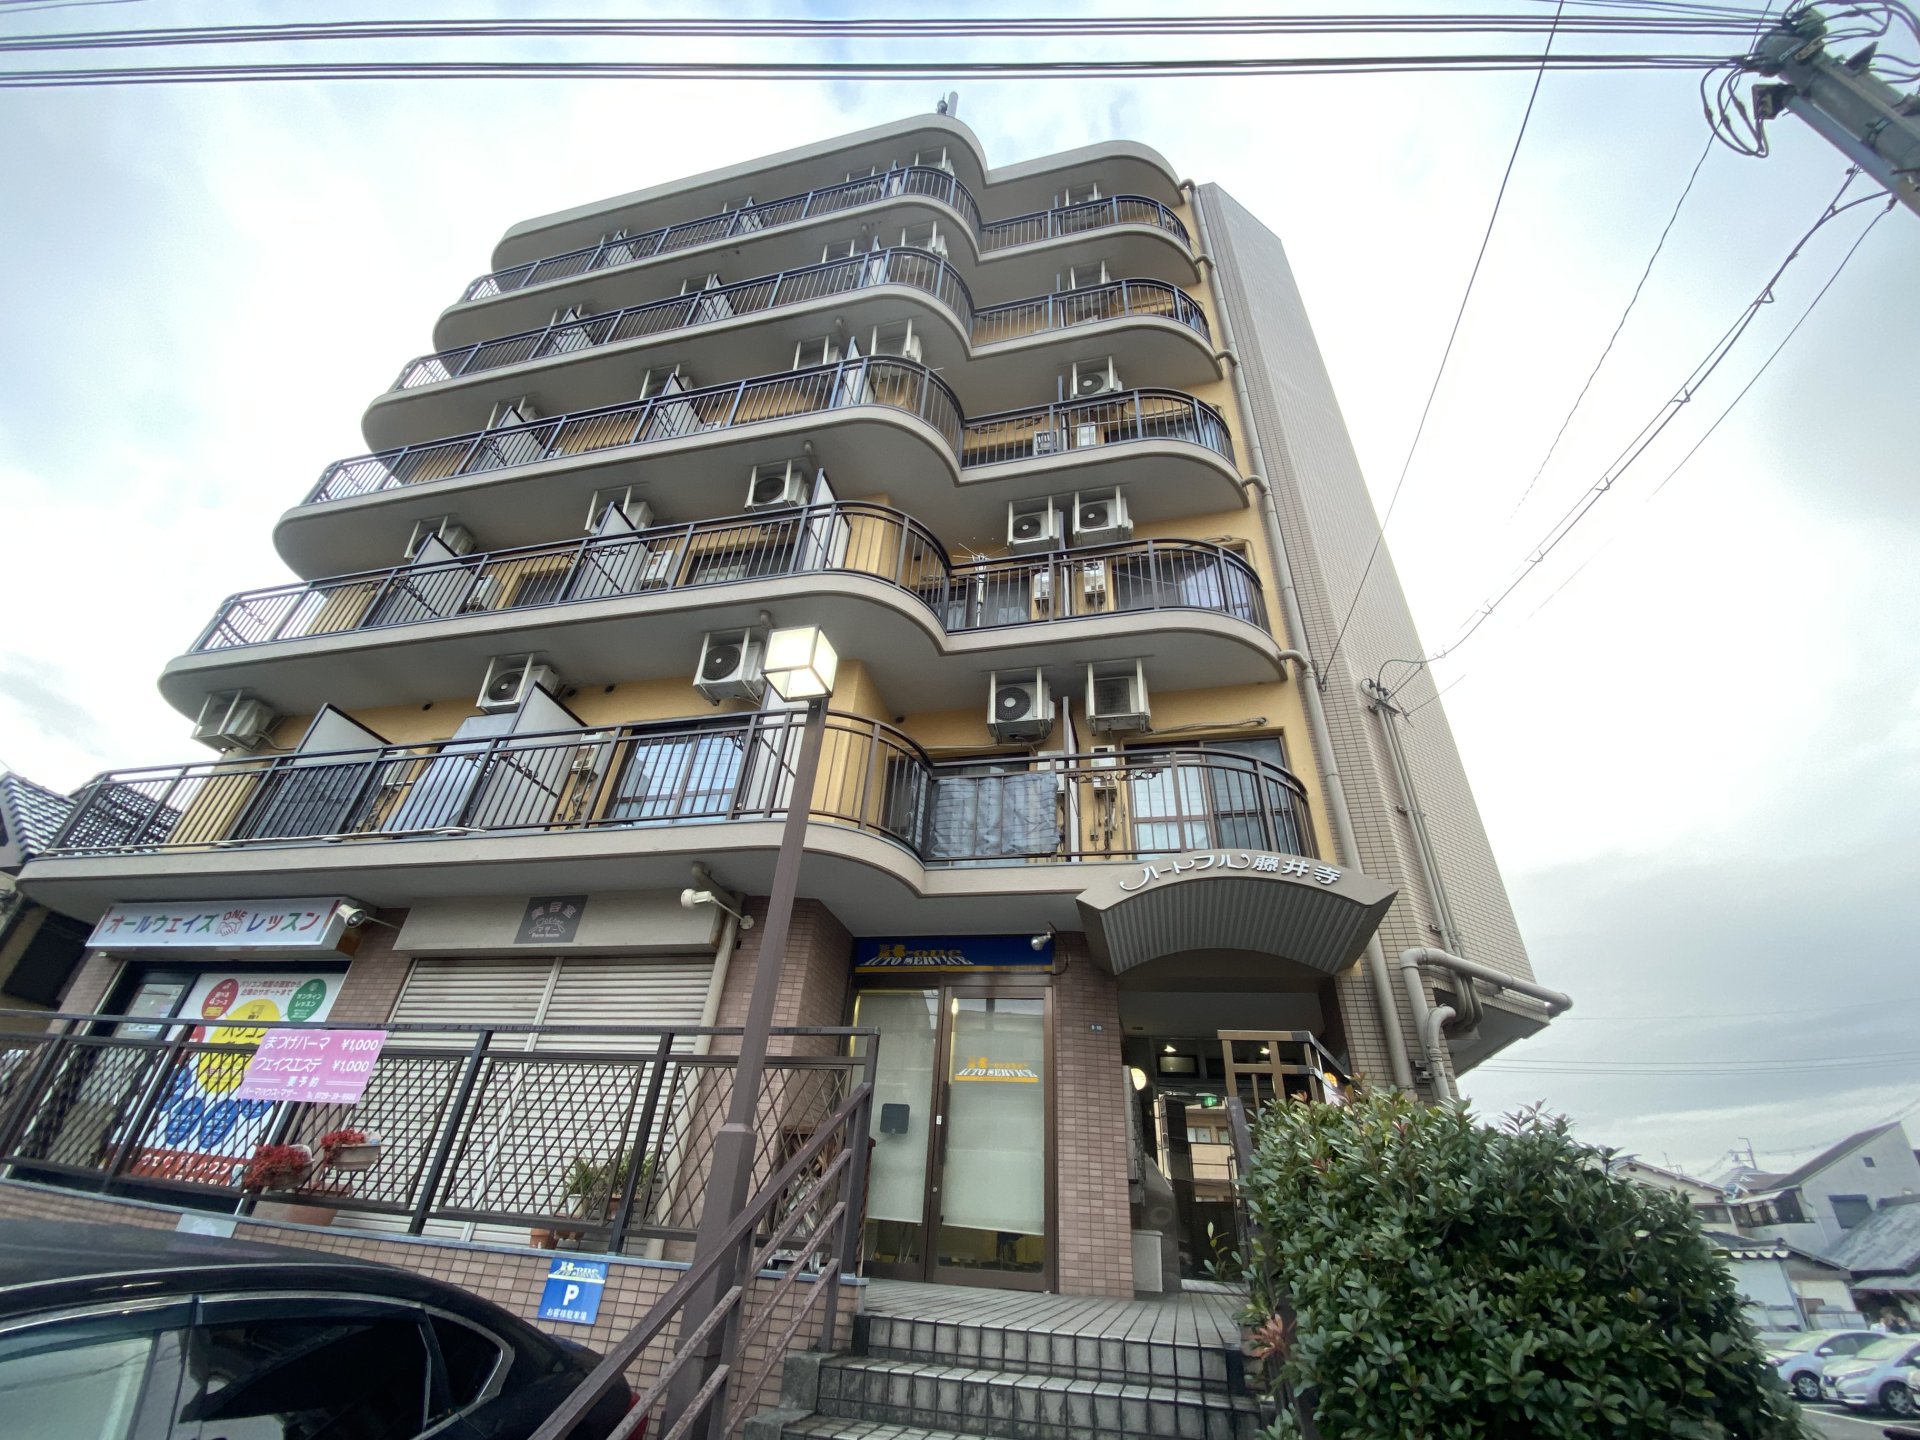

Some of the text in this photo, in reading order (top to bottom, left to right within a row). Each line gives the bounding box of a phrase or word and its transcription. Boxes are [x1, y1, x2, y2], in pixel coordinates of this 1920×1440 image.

[1119, 853, 1342, 891] ハートフル藤井寺
[105, 909, 321, 934] オールウェイズ ONE レッスン
[341, 1039, 379, 1052] ¥1,000
[255, 1057, 370, 1072] フェイスエステ ¥1,000
[563, 1284, 580, 1306] P
